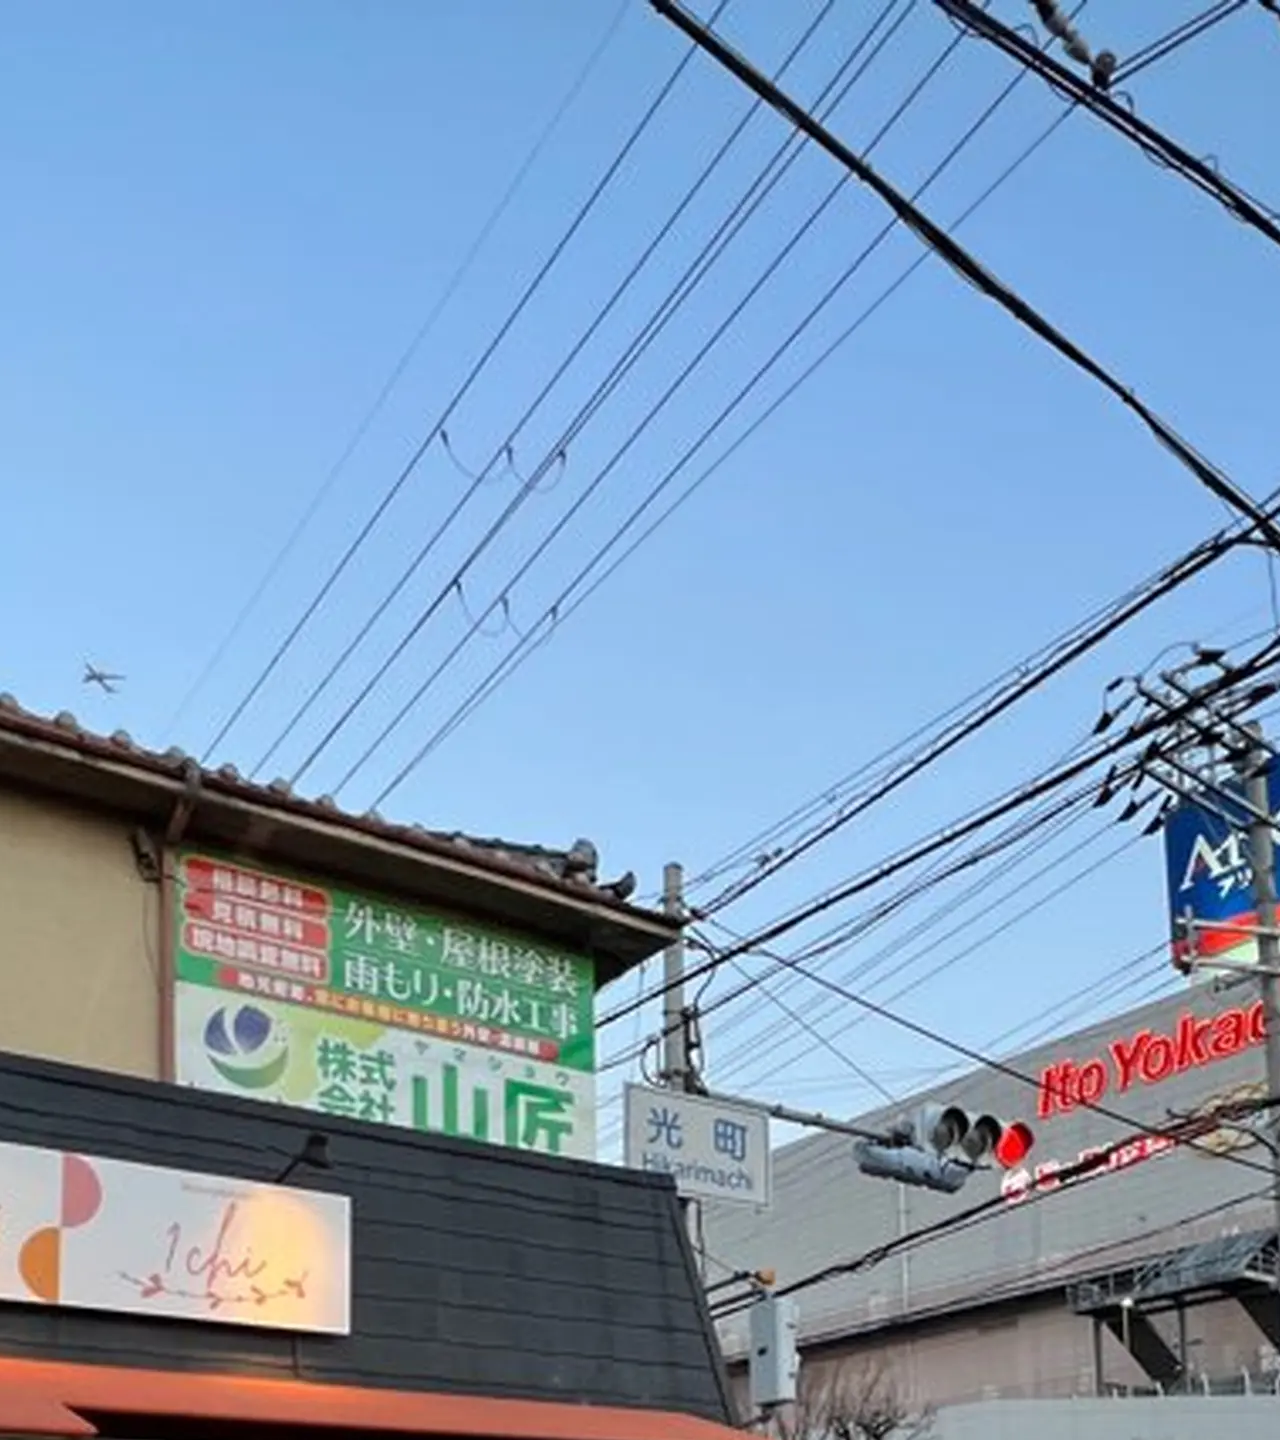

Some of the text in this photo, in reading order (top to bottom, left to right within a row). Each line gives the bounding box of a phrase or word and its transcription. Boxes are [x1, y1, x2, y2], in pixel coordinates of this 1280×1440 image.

[1217, 866, 1254, 899] アリ
[343, 955, 580, 1040] 雨もり・防水工事
[317, 1037, 397, 1092] 株式
[1037, 1056, 1108, 1120] Ito
[646, 1107, 747, 1162] 光町
